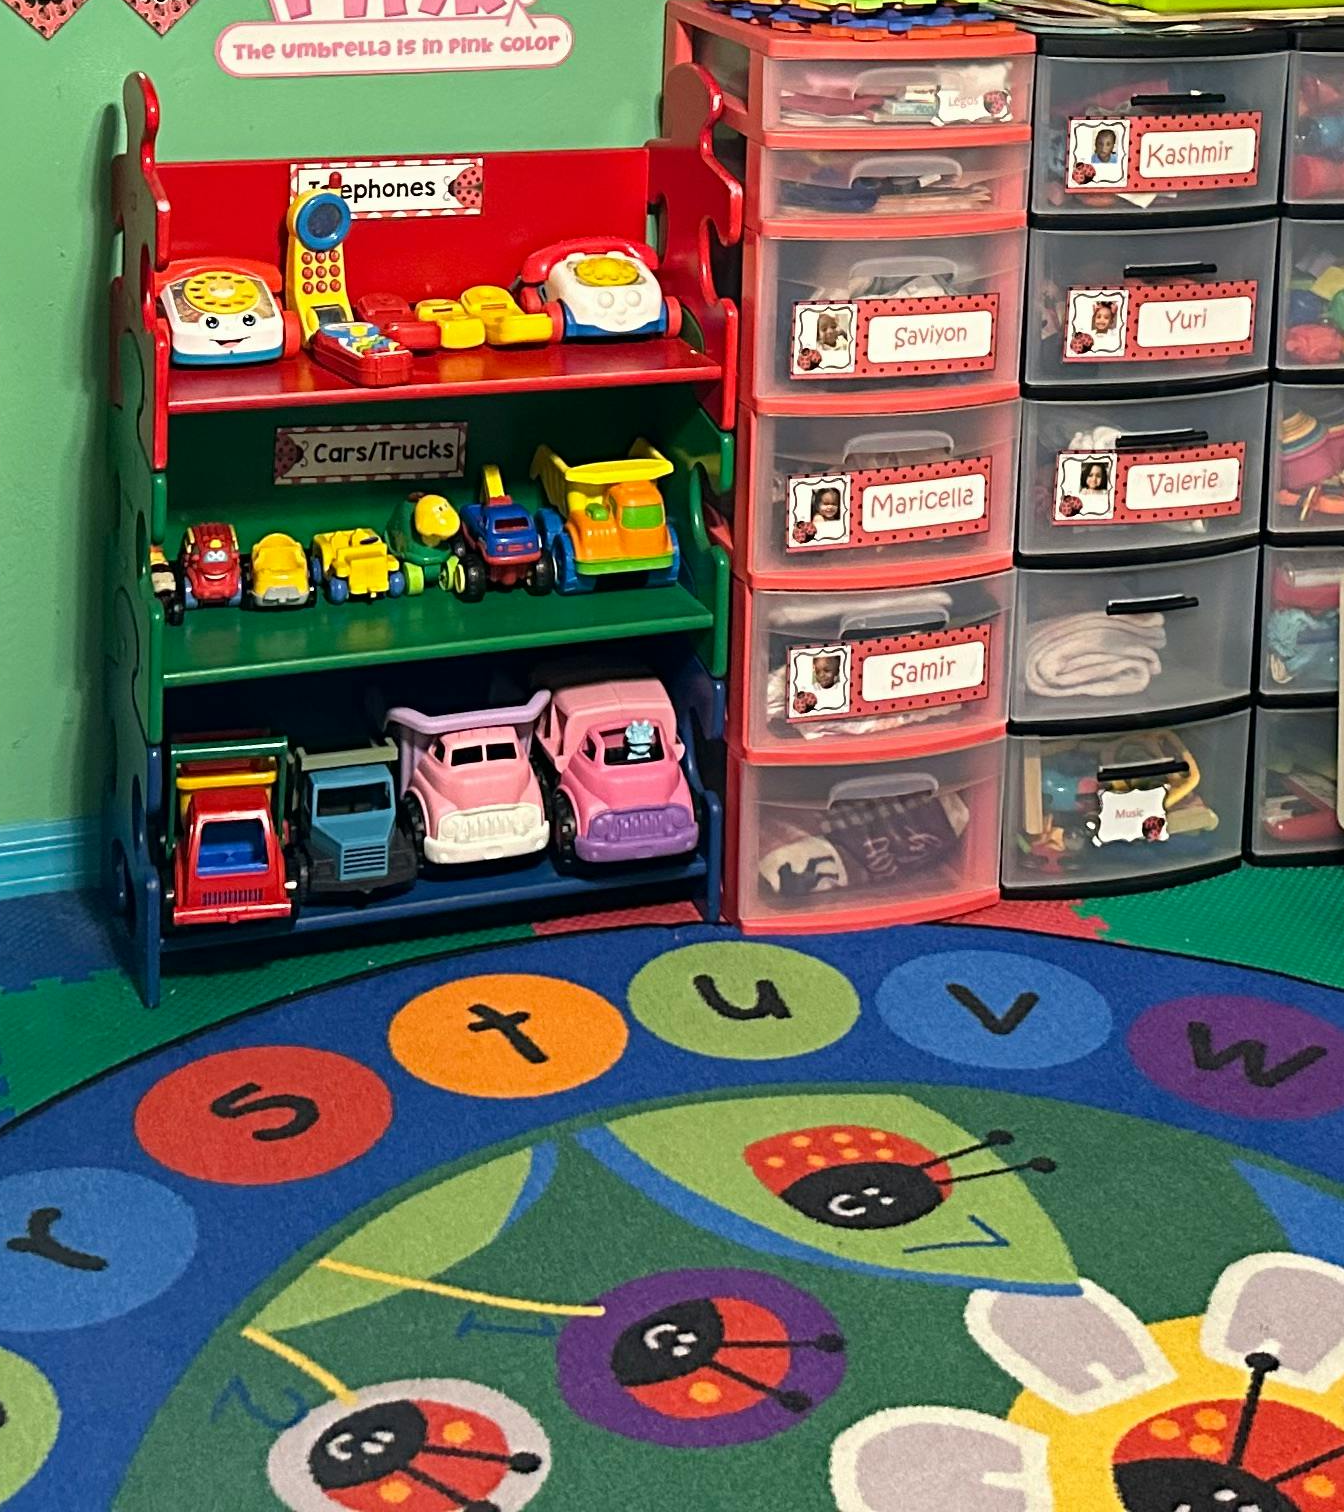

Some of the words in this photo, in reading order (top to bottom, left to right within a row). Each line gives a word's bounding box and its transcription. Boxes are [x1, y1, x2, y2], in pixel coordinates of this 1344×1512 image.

[233, 43, 276, 61] The
[281, 40, 391, 59] umbrella
[396, 37, 415, 56] is
[422, 37, 444, 55] in
[500, 34, 561, 53] color
[1146, 140, 1233, 169] Kashmir
[308, 178, 436, 204] ephones
[1165, 308, 1208, 333] Yuri
[894, 325, 968, 351] Saviyon
[313, 438, 455, 465] Cars/Trucks
[1146, 469, 1219, 497] Valerie
[870, 486, 975, 519] Maricella
[890, 656, 957, 689] Samir
[1114, 808, 1144, 819] Music
[6, 1206, 109, 1272] r
[467, 1002, 550, 1065] t
[692, 973, 792, 1021] u
